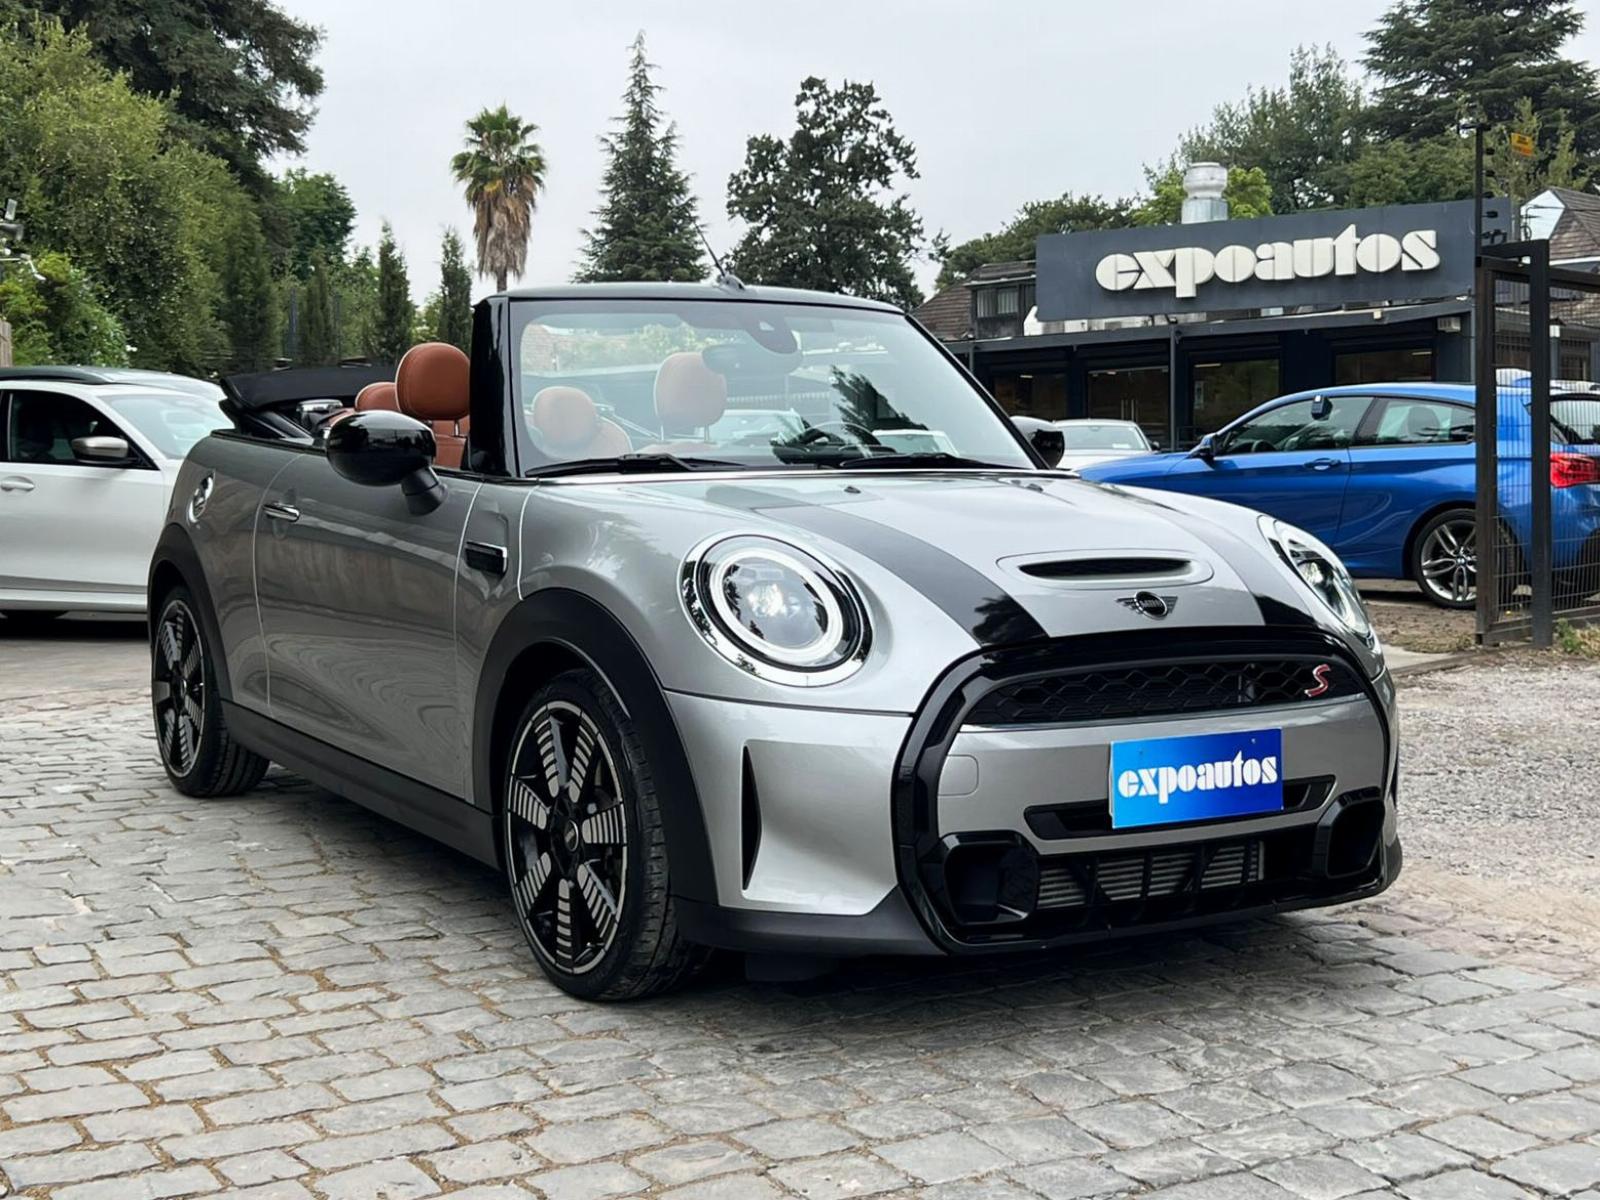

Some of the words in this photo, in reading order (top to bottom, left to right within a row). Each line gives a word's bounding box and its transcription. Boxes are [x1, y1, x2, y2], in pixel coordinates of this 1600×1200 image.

[1095, 224, 1441, 298] expoautos
[1303, 663, 1331, 697] S
[1117, 750, 1278, 804] expoautos
